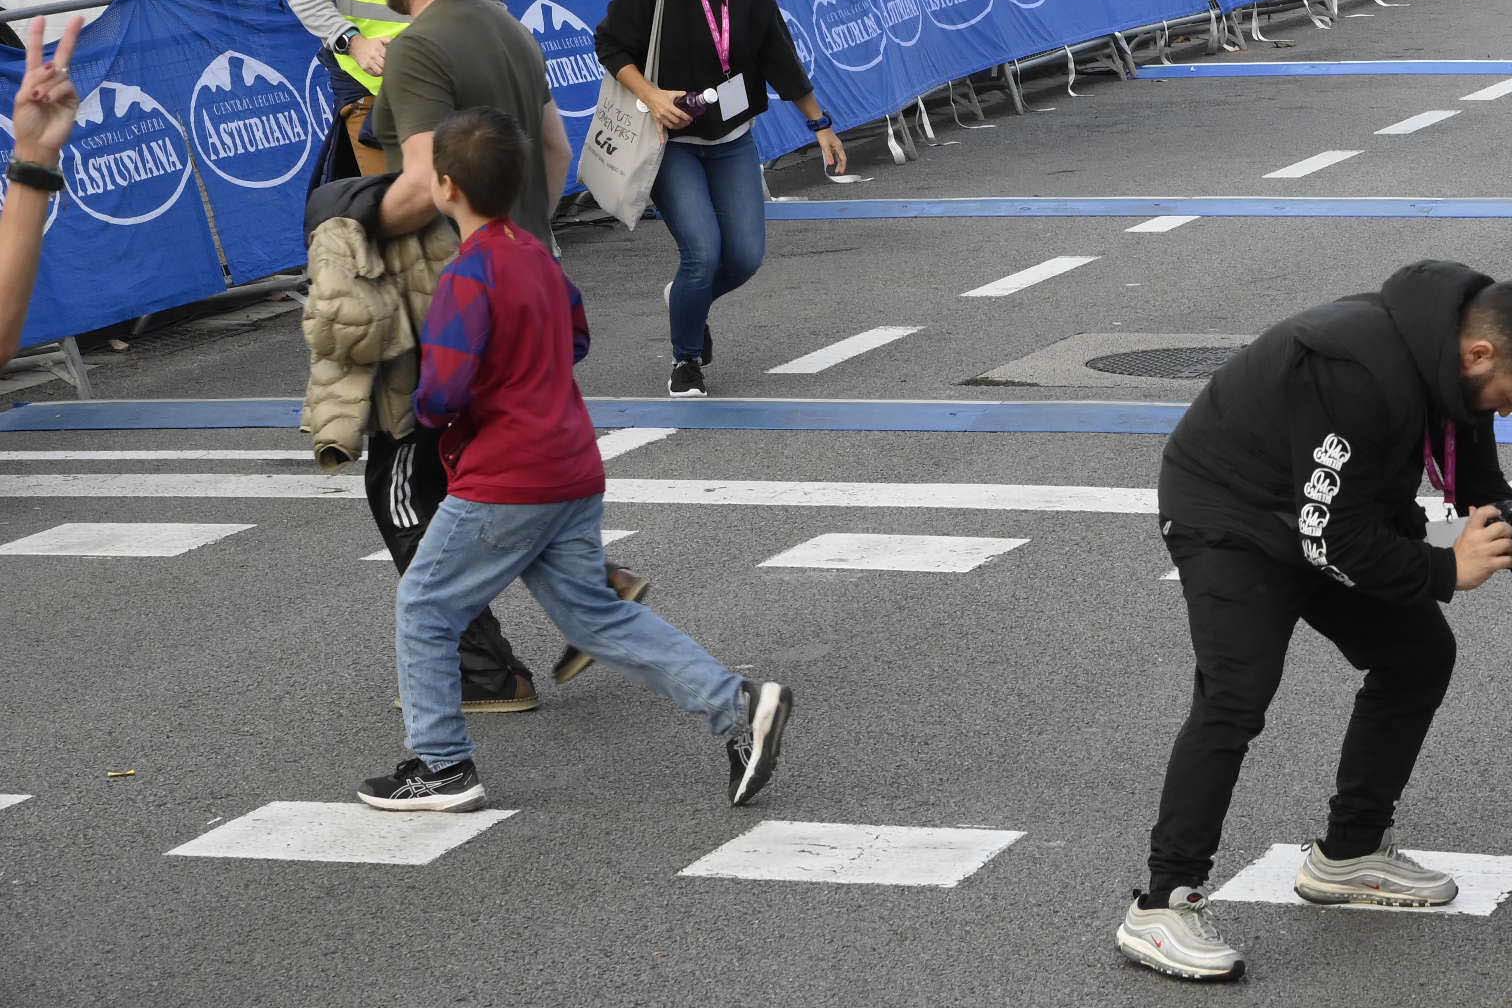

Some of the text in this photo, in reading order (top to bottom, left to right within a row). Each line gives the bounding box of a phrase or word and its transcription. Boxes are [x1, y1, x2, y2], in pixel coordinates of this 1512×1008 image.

[545, 51, 607, 90] TURIANA
[213, 95, 251, 116] CENTRAL
[201, 107, 307, 162] ASTURIANA
